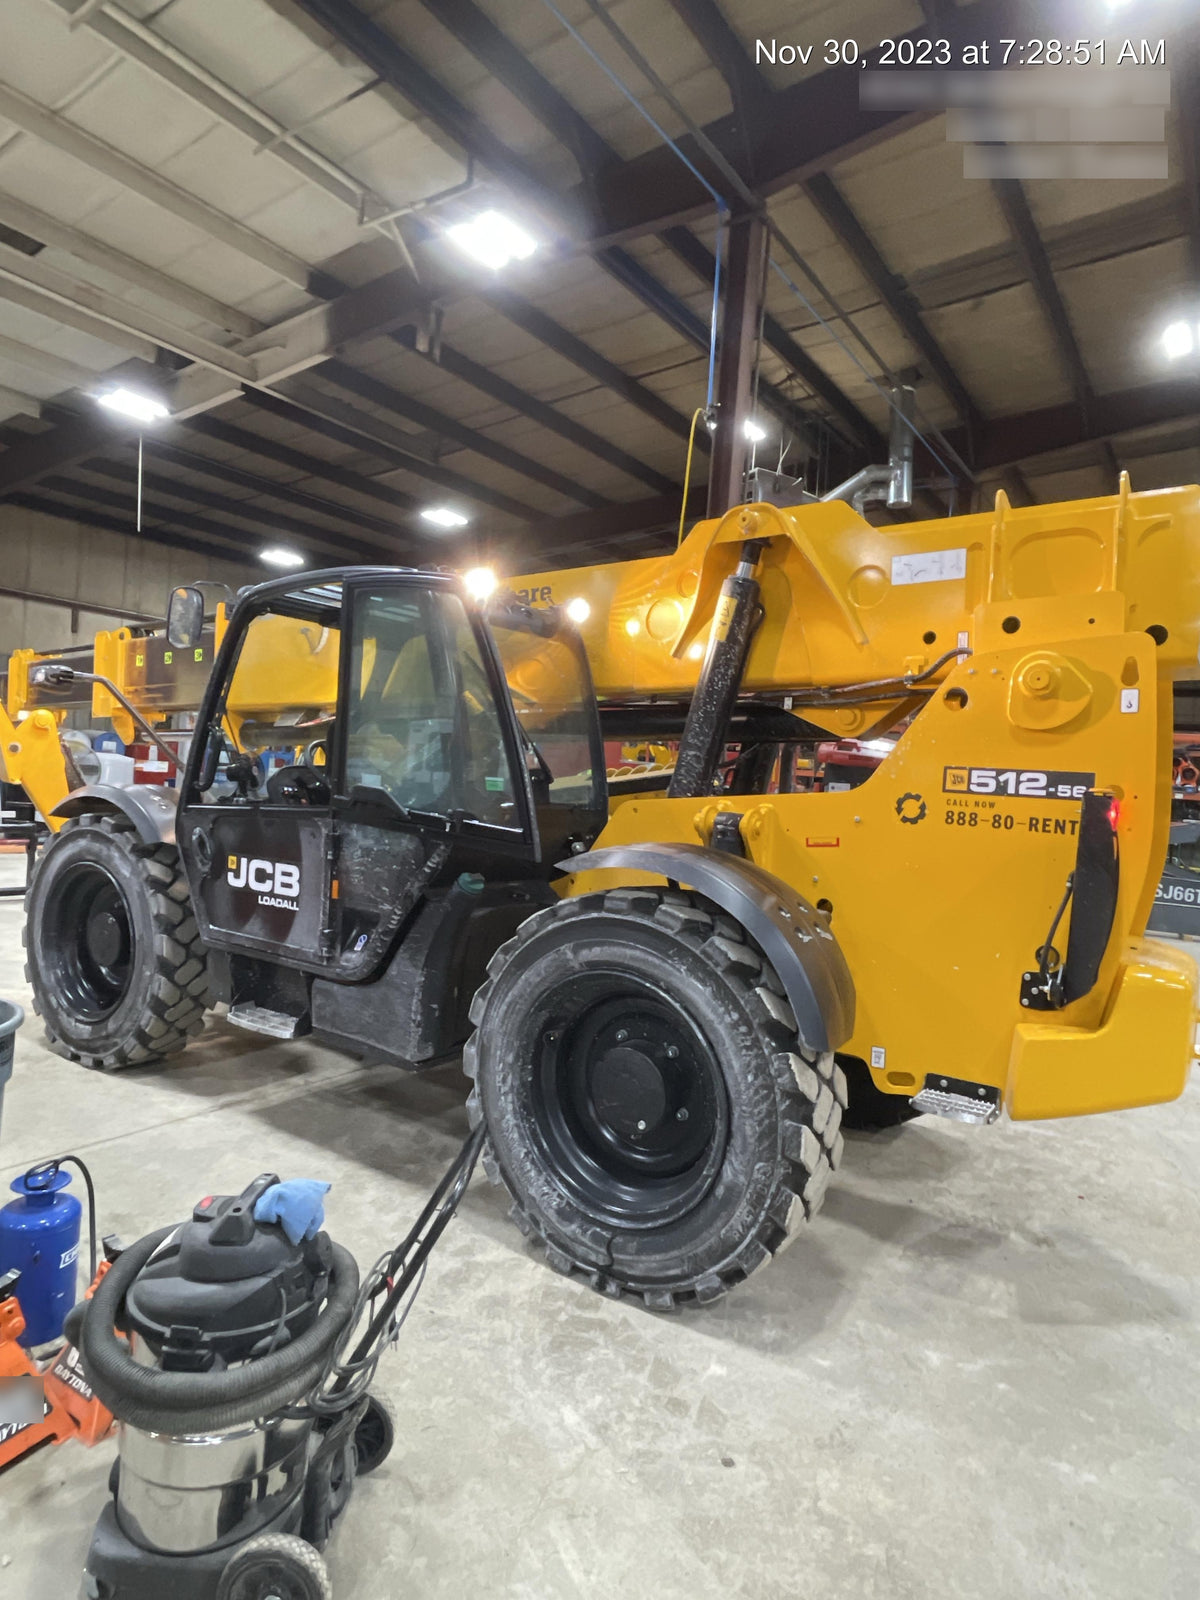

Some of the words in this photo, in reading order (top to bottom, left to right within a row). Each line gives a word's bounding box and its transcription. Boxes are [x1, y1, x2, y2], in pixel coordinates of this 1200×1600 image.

[517, 585, 552, 604] are
[946, 798, 970, 808] CALL
[974, 800, 996, 809] NOW
[944, 810, 1079, 836] 888-80-RENT
[227, 856, 300, 897] JCB
[258, 895, 300, 911] LOADALL
[54, 1364, 93, 1398] DAYTONA
